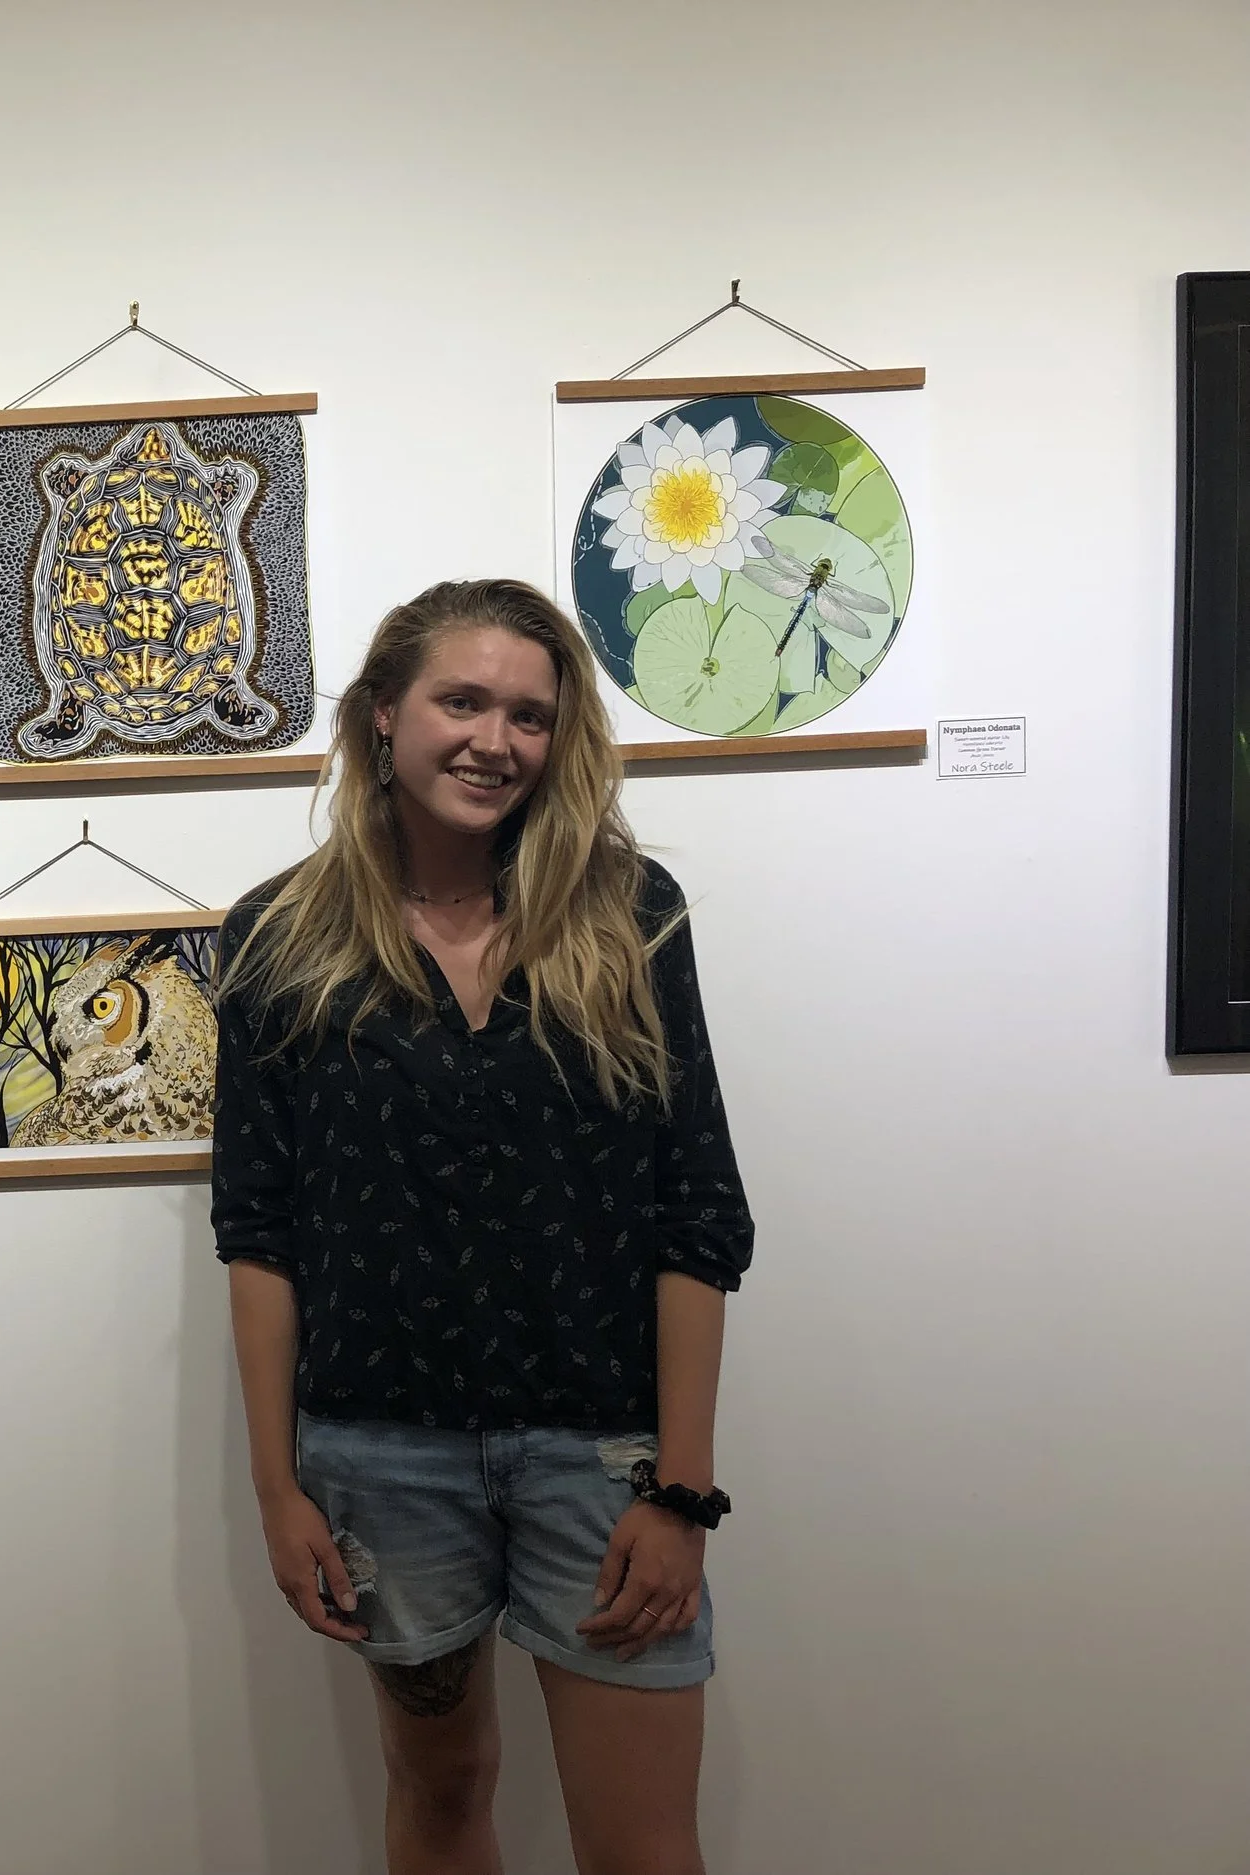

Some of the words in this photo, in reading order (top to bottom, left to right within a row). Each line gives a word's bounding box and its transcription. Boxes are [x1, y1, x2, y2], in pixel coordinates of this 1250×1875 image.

[943, 725, 986, 735] Nymphaea
[987, 724, 1021, 732] Odonata
[951, 764, 977, 773] Nora
[980, 760, 1014, 772] Steele
